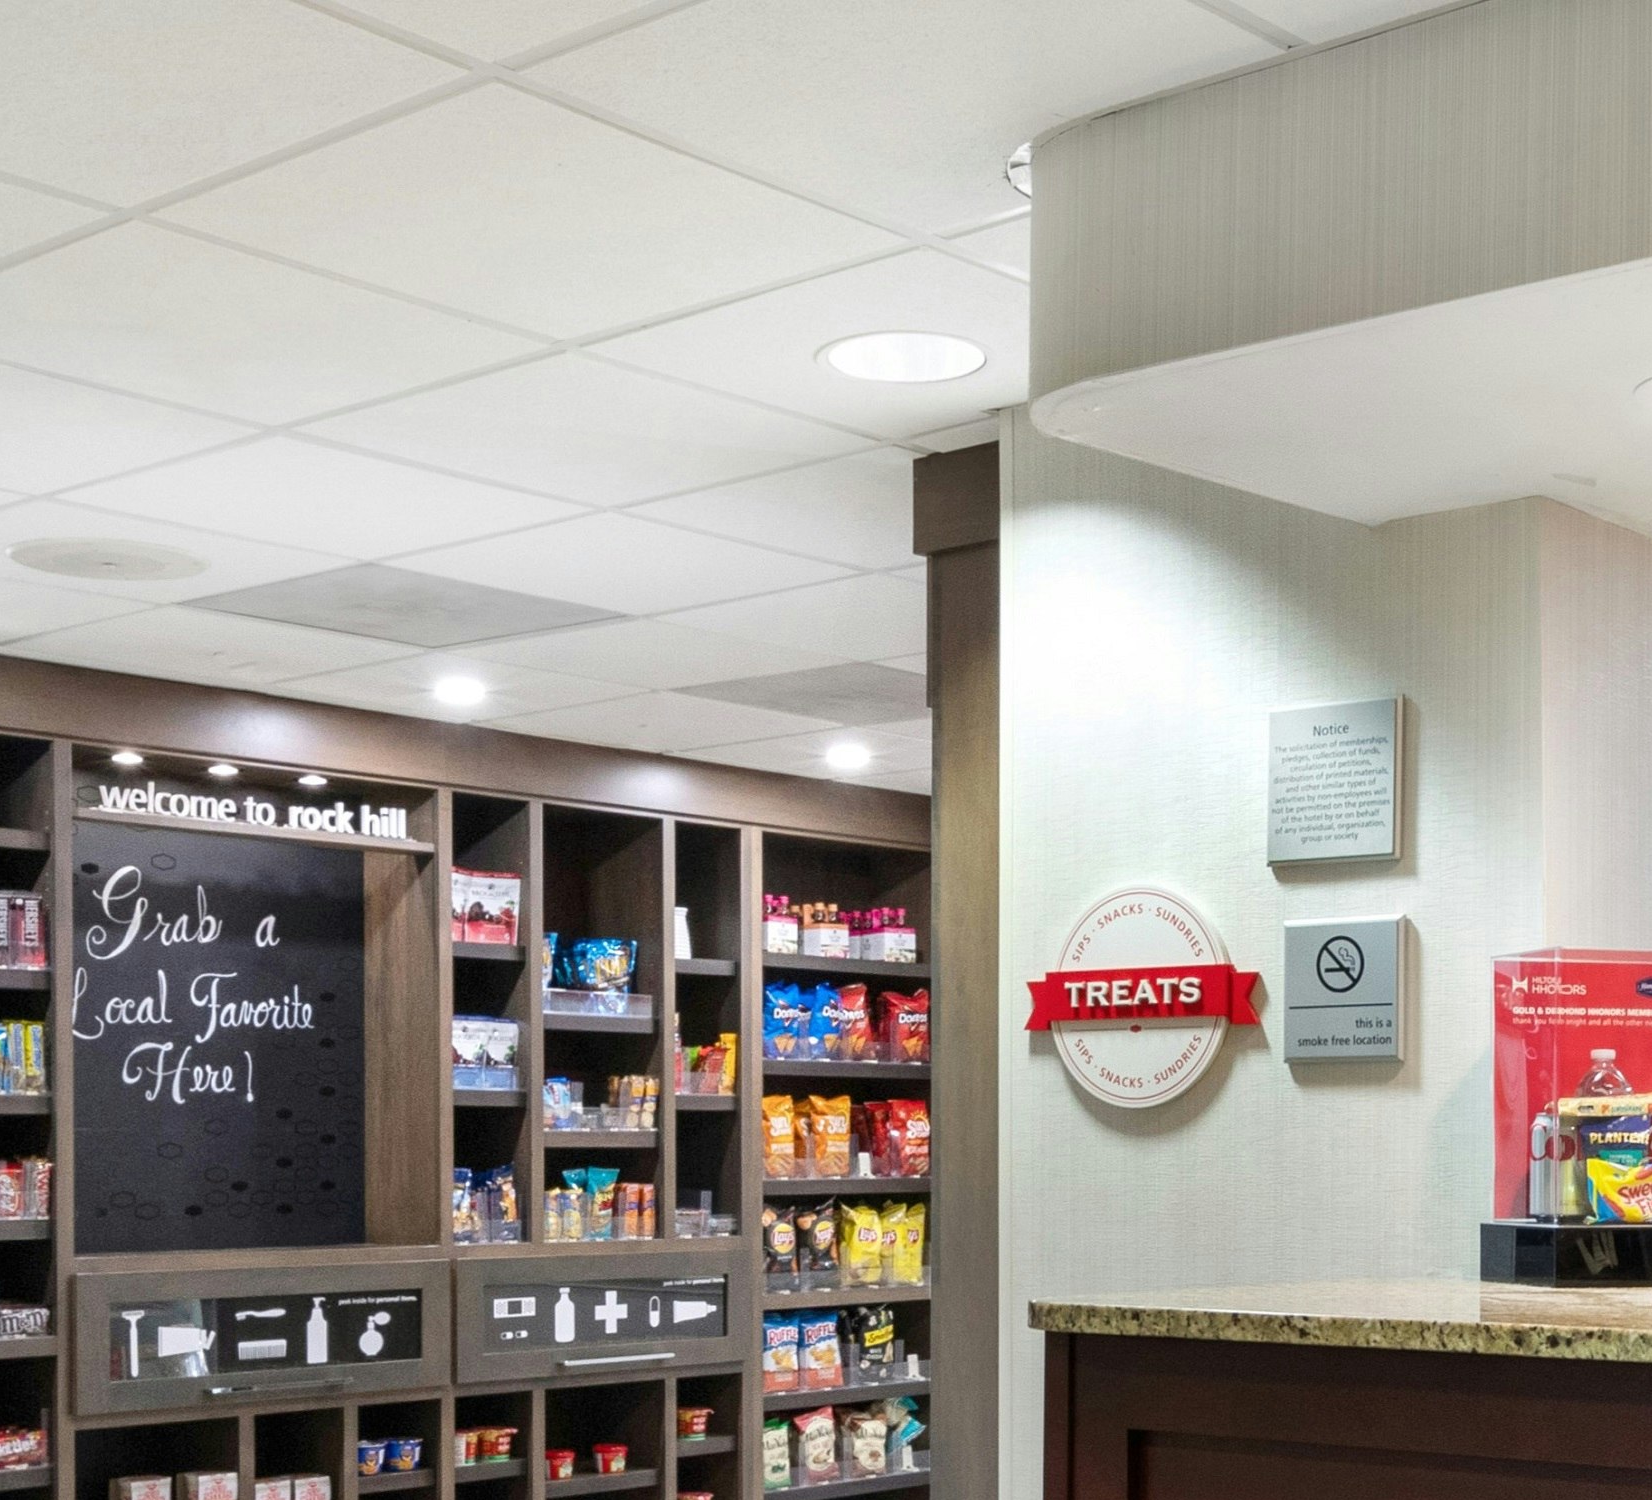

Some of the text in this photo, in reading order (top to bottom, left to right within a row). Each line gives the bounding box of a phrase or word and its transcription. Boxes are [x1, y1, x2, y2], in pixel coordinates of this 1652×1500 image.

[1312, 723, 1350, 737] Notice
[1325, 770, 1352, 781] printed
[1300, 782, 1320, 791] other
[1347, 779, 1366, 789] types
[99, 781, 407, 840] welcome to rock hill
[1304, 811, 1323, 822] hotel
[1300, 834, 1323, 845] group
[1334, 831, 1359, 842] society
[86, 865, 281, 960] Grab a
[1072, 903, 1205, 963] SIPS SNACKS SUNDRIES
[1063, 976, 1203, 1008] TREATS
[72, 966, 316, 1043] Local Favorite
[1355, 1016, 1392, 1029] this is a
[1297, 1033, 1392, 1047] smoke free location
[1074, 1034, 1203, 1089] SIPS SNACKS SUNDRIES
